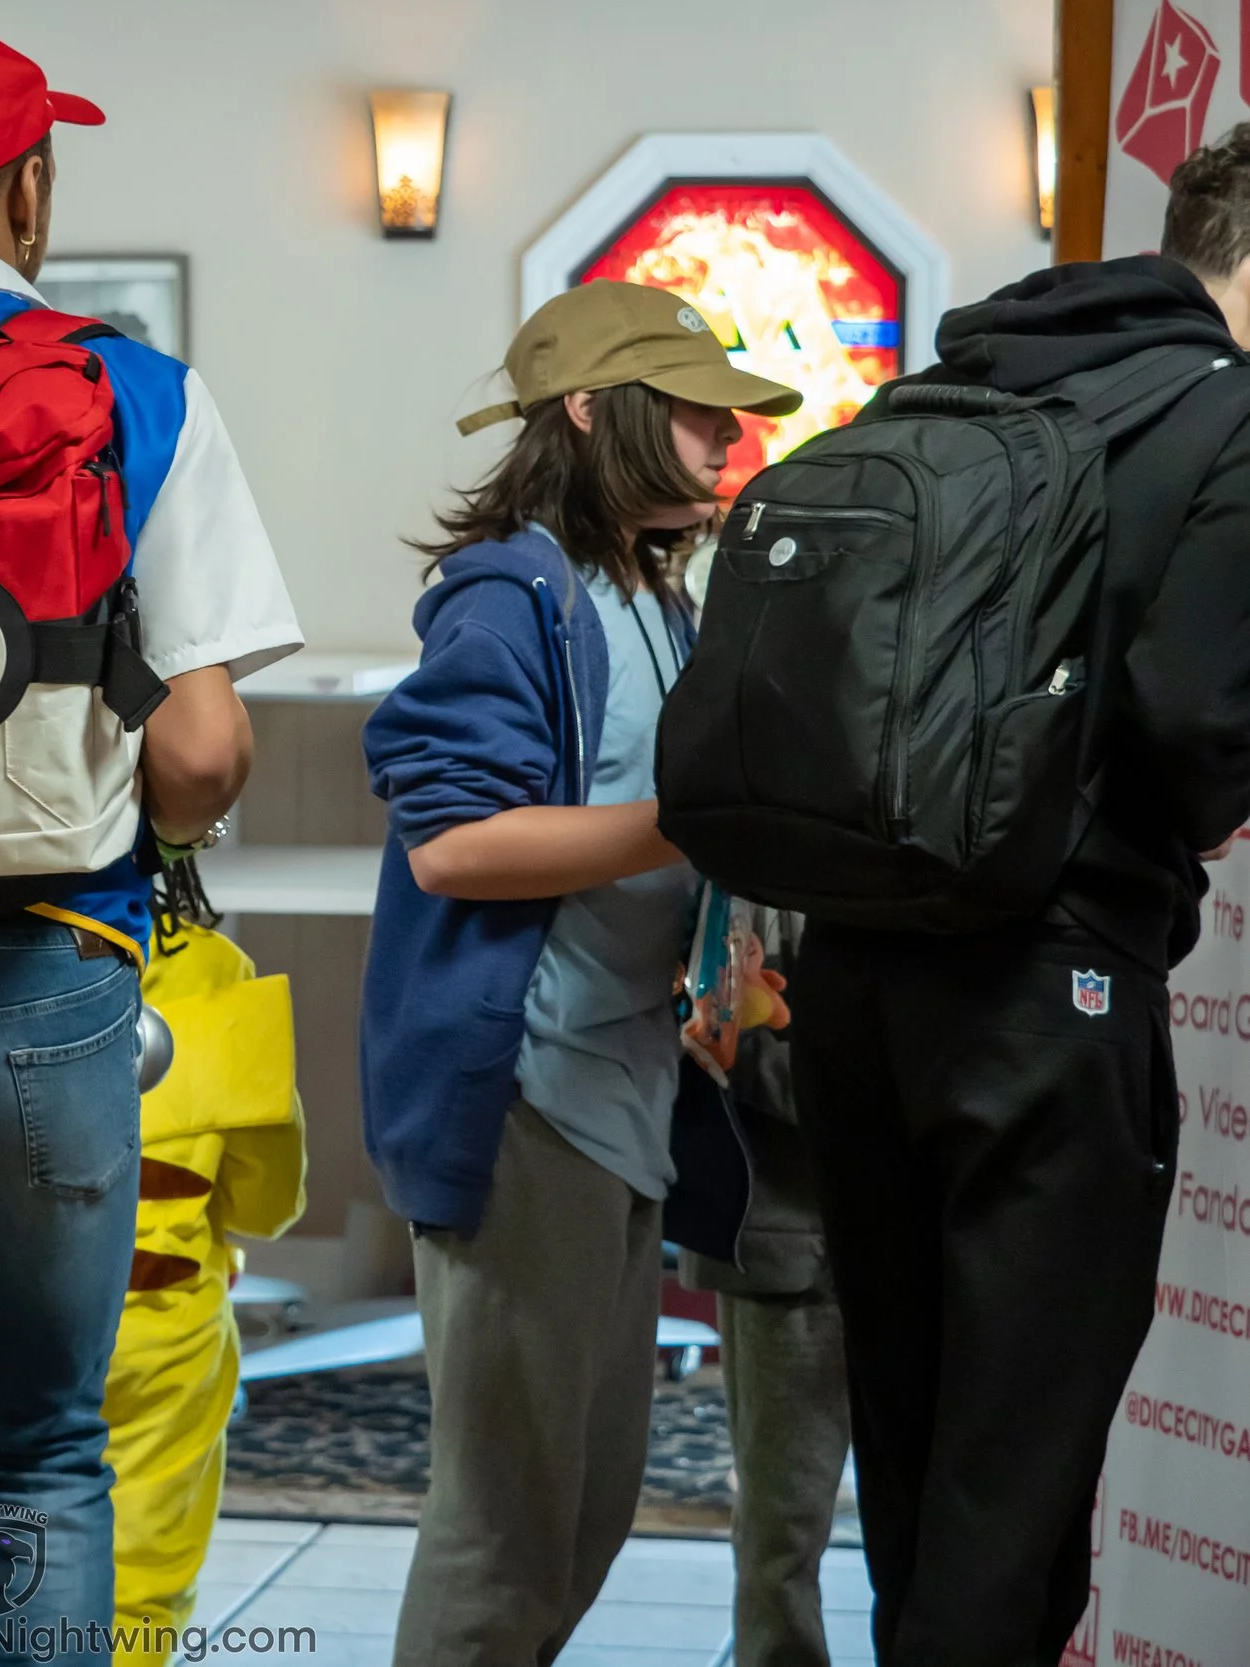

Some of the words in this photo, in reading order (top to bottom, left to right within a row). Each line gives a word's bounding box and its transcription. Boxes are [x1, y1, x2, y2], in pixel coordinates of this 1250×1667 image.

[1213, 889, 1244, 942] the
[1079, 988, 1104, 1009] NFL
[1170, 990, 1231, 1035] oard
